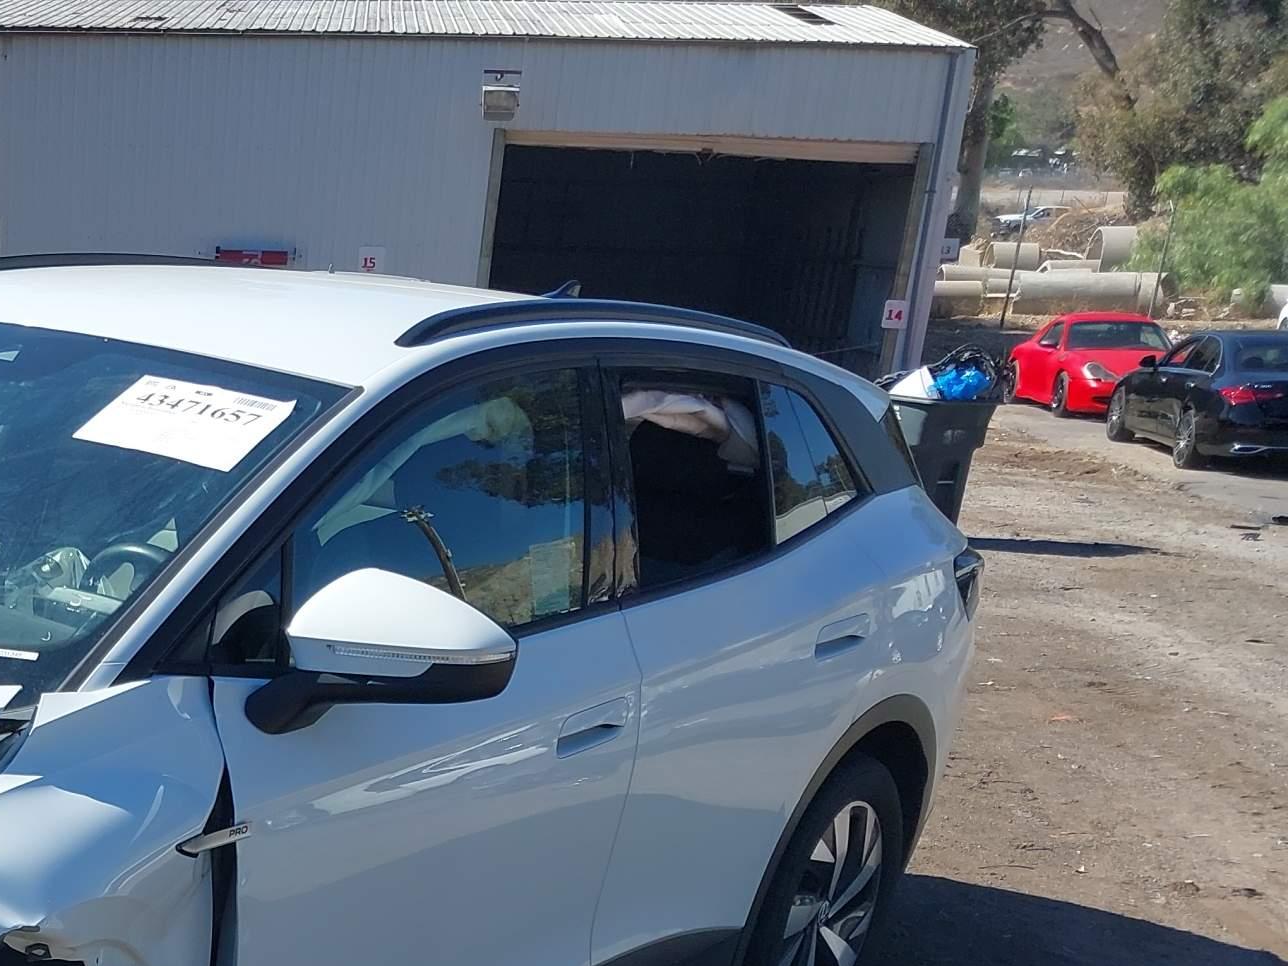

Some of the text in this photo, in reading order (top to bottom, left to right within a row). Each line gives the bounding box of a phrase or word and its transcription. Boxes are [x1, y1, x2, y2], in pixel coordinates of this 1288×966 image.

[361, 257, 376, 269] 15
[885, 309, 903, 321] 14
[136, 392, 263, 427] 43471657
[229, 825, 248, 837] PRO
